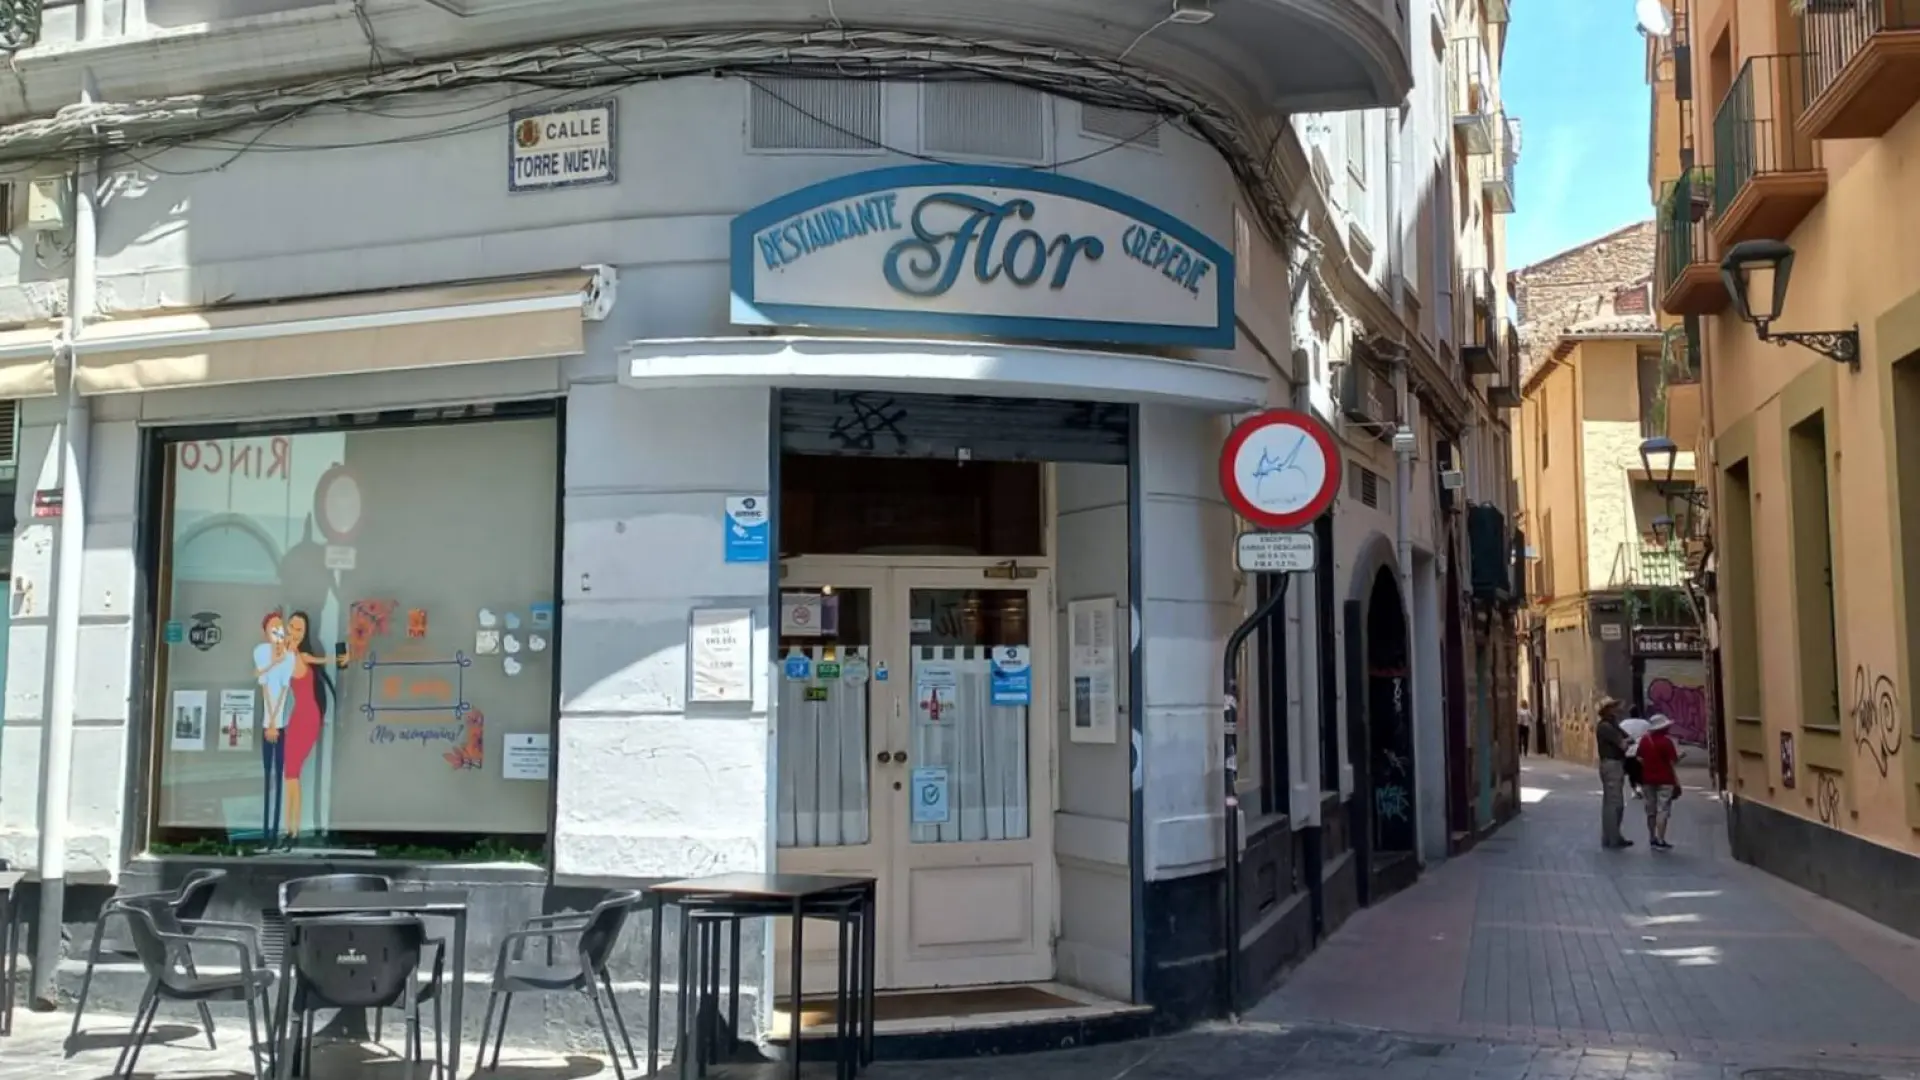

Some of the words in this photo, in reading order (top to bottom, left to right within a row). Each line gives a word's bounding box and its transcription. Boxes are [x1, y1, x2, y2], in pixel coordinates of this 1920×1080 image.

[546, 117, 602, 140] CALLE
[515, 152, 560, 179] TORRE
[562, 147, 608, 174] NUEVA
[757, 191, 903, 271] RESTAURANTE
[882, 192, 1105, 298] Flor
